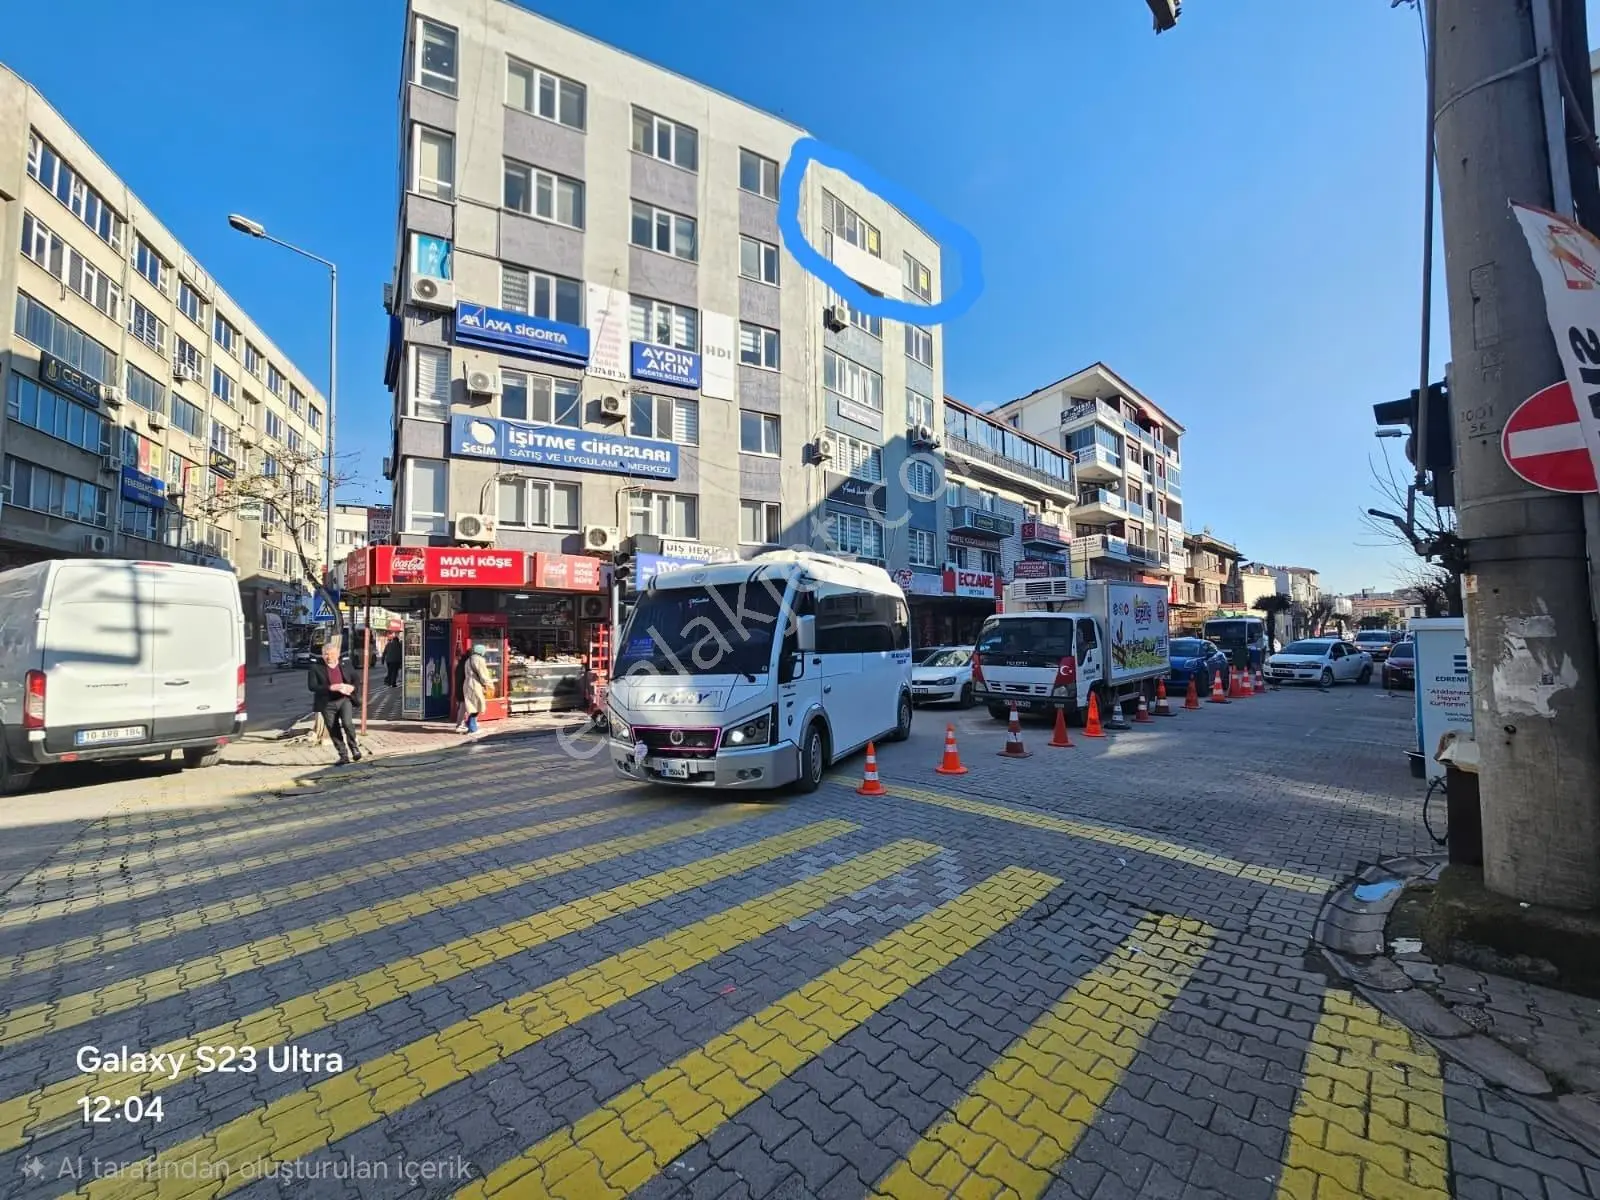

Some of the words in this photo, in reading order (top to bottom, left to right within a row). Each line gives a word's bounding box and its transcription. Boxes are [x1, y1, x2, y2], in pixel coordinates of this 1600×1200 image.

[486, 319, 513, 333] AXA
[642, 347, 693, 367] AYDIN
[705, 345, 731, 360] HDI
[508, 428, 576, 451] İŞİTME
[581, 438, 670, 463] CİHAZLARI
[508, 449, 543, 461] SATIŞ
[546, 453, 561, 462] VE
[564, 456, 625, 469] UYGULAM
[440, 555, 475, 566] MAVİ
[477, 556, 512, 568] KÖŞE
[440, 567, 476, 578] BÜFE
[959, 571, 993, 588] ECZANE
